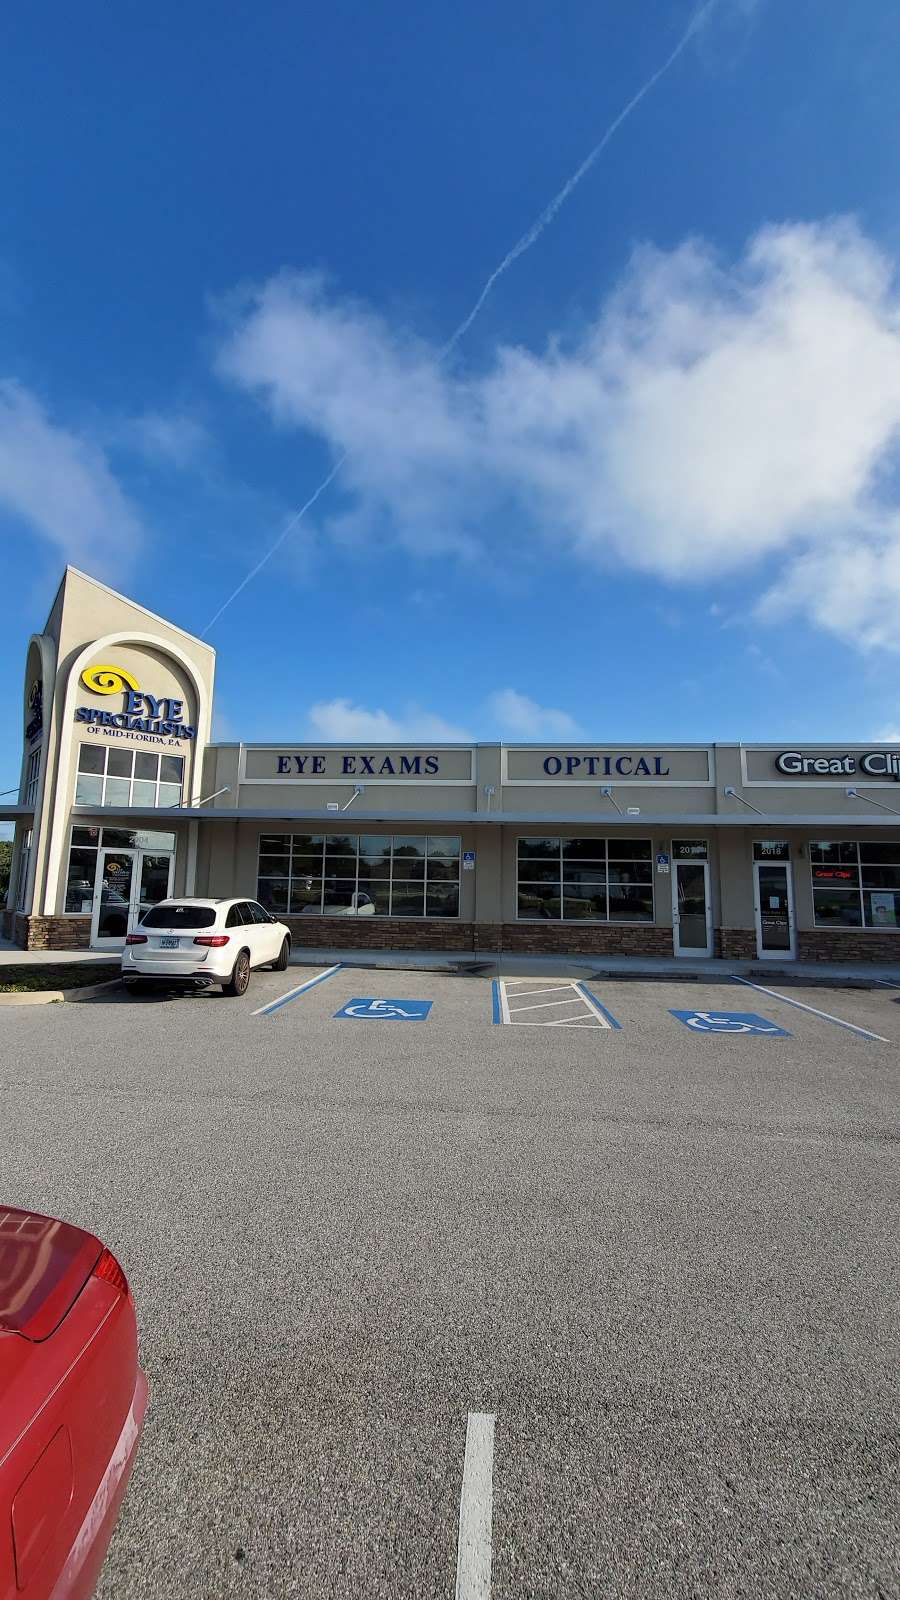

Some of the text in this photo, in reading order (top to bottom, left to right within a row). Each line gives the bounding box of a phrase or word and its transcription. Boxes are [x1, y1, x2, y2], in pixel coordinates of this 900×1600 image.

[124, 691, 183, 722] EYE
[76, 707, 195, 739] SPECIALISTS
[87, 726, 101, 735] OF
[277, 755, 439, 774] EYE EXAMS
[543, 756, 670, 775] OPTICAL
[777, 751, 900, 781] Great Cli
